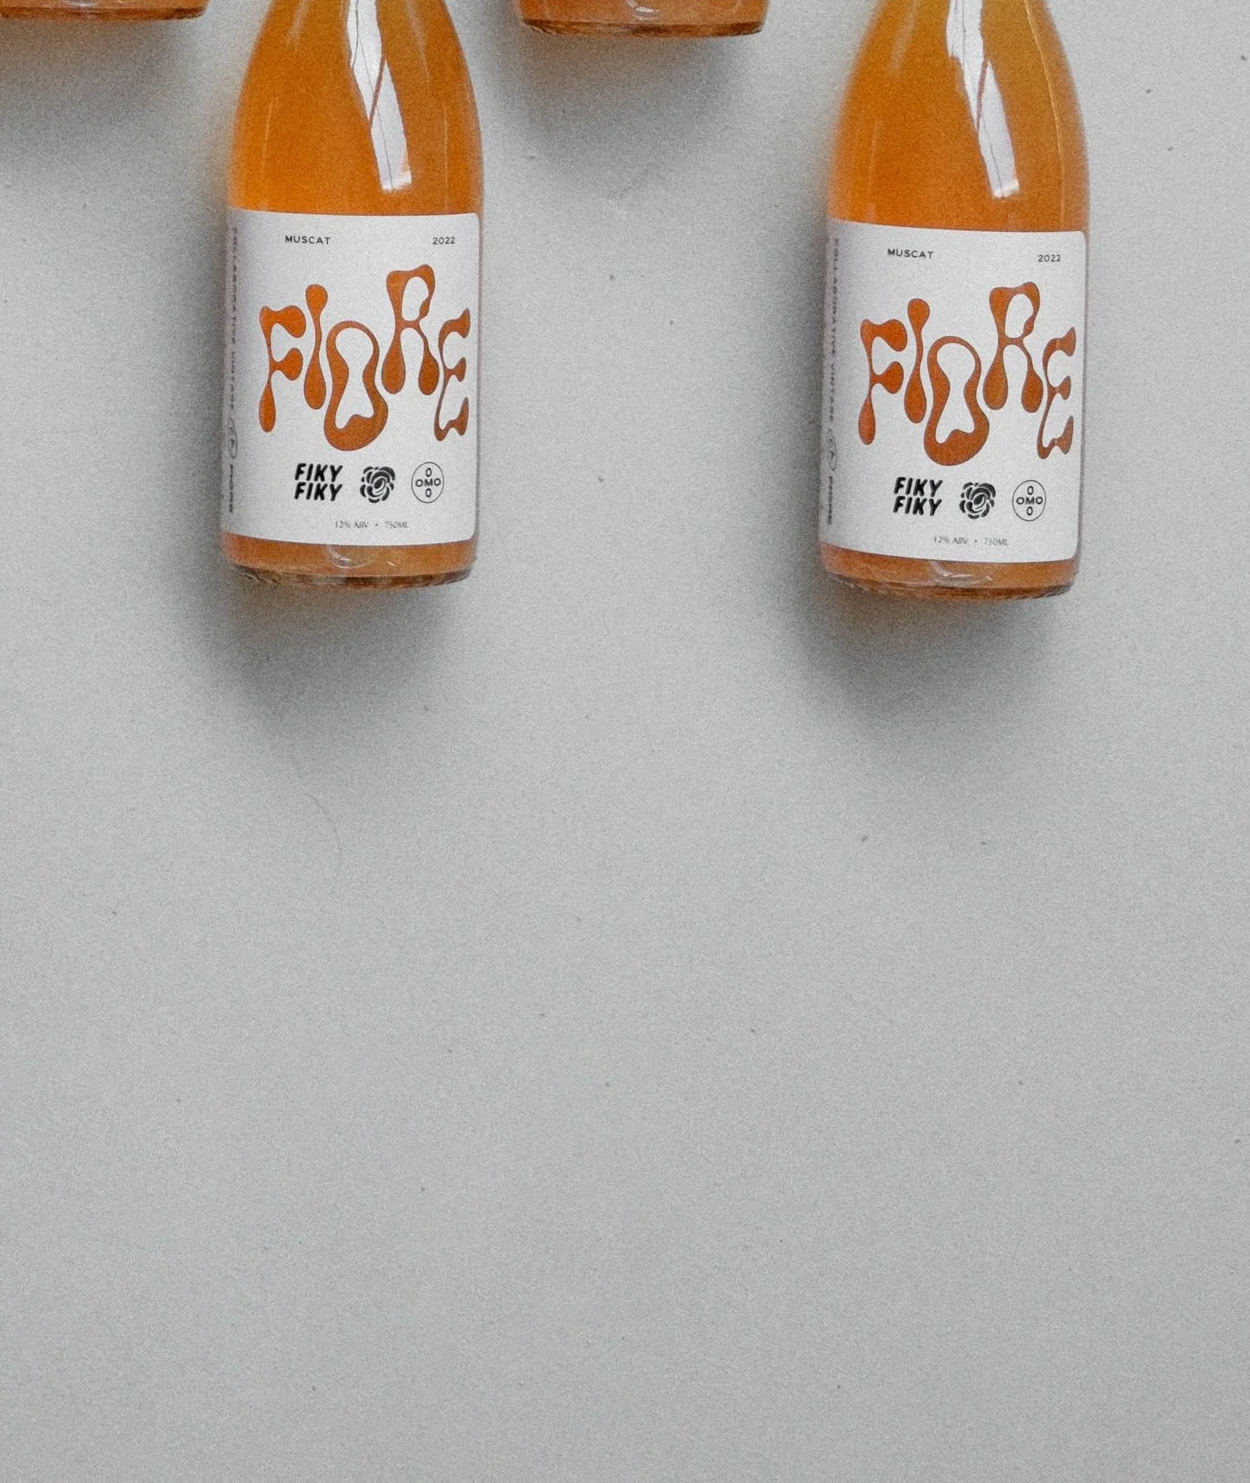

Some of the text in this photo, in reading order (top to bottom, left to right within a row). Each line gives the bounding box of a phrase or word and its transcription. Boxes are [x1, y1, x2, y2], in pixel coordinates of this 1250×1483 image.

[285, 235, 330, 244] MUSCAT
[433, 236, 455, 245] 2022
[888, 249, 933, 258] MUSCAT
[1038, 254, 1060, 262] 2022
[258, 264, 470, 451] FIORE
[858, 282, 1076, 467] FIORE
[295, 463, 342, 482] FIKY
[295, 482, 342, 501] FIKY
[894, 477, 942, 497] FIKY
[894, 496, 941, 515] FIKY
